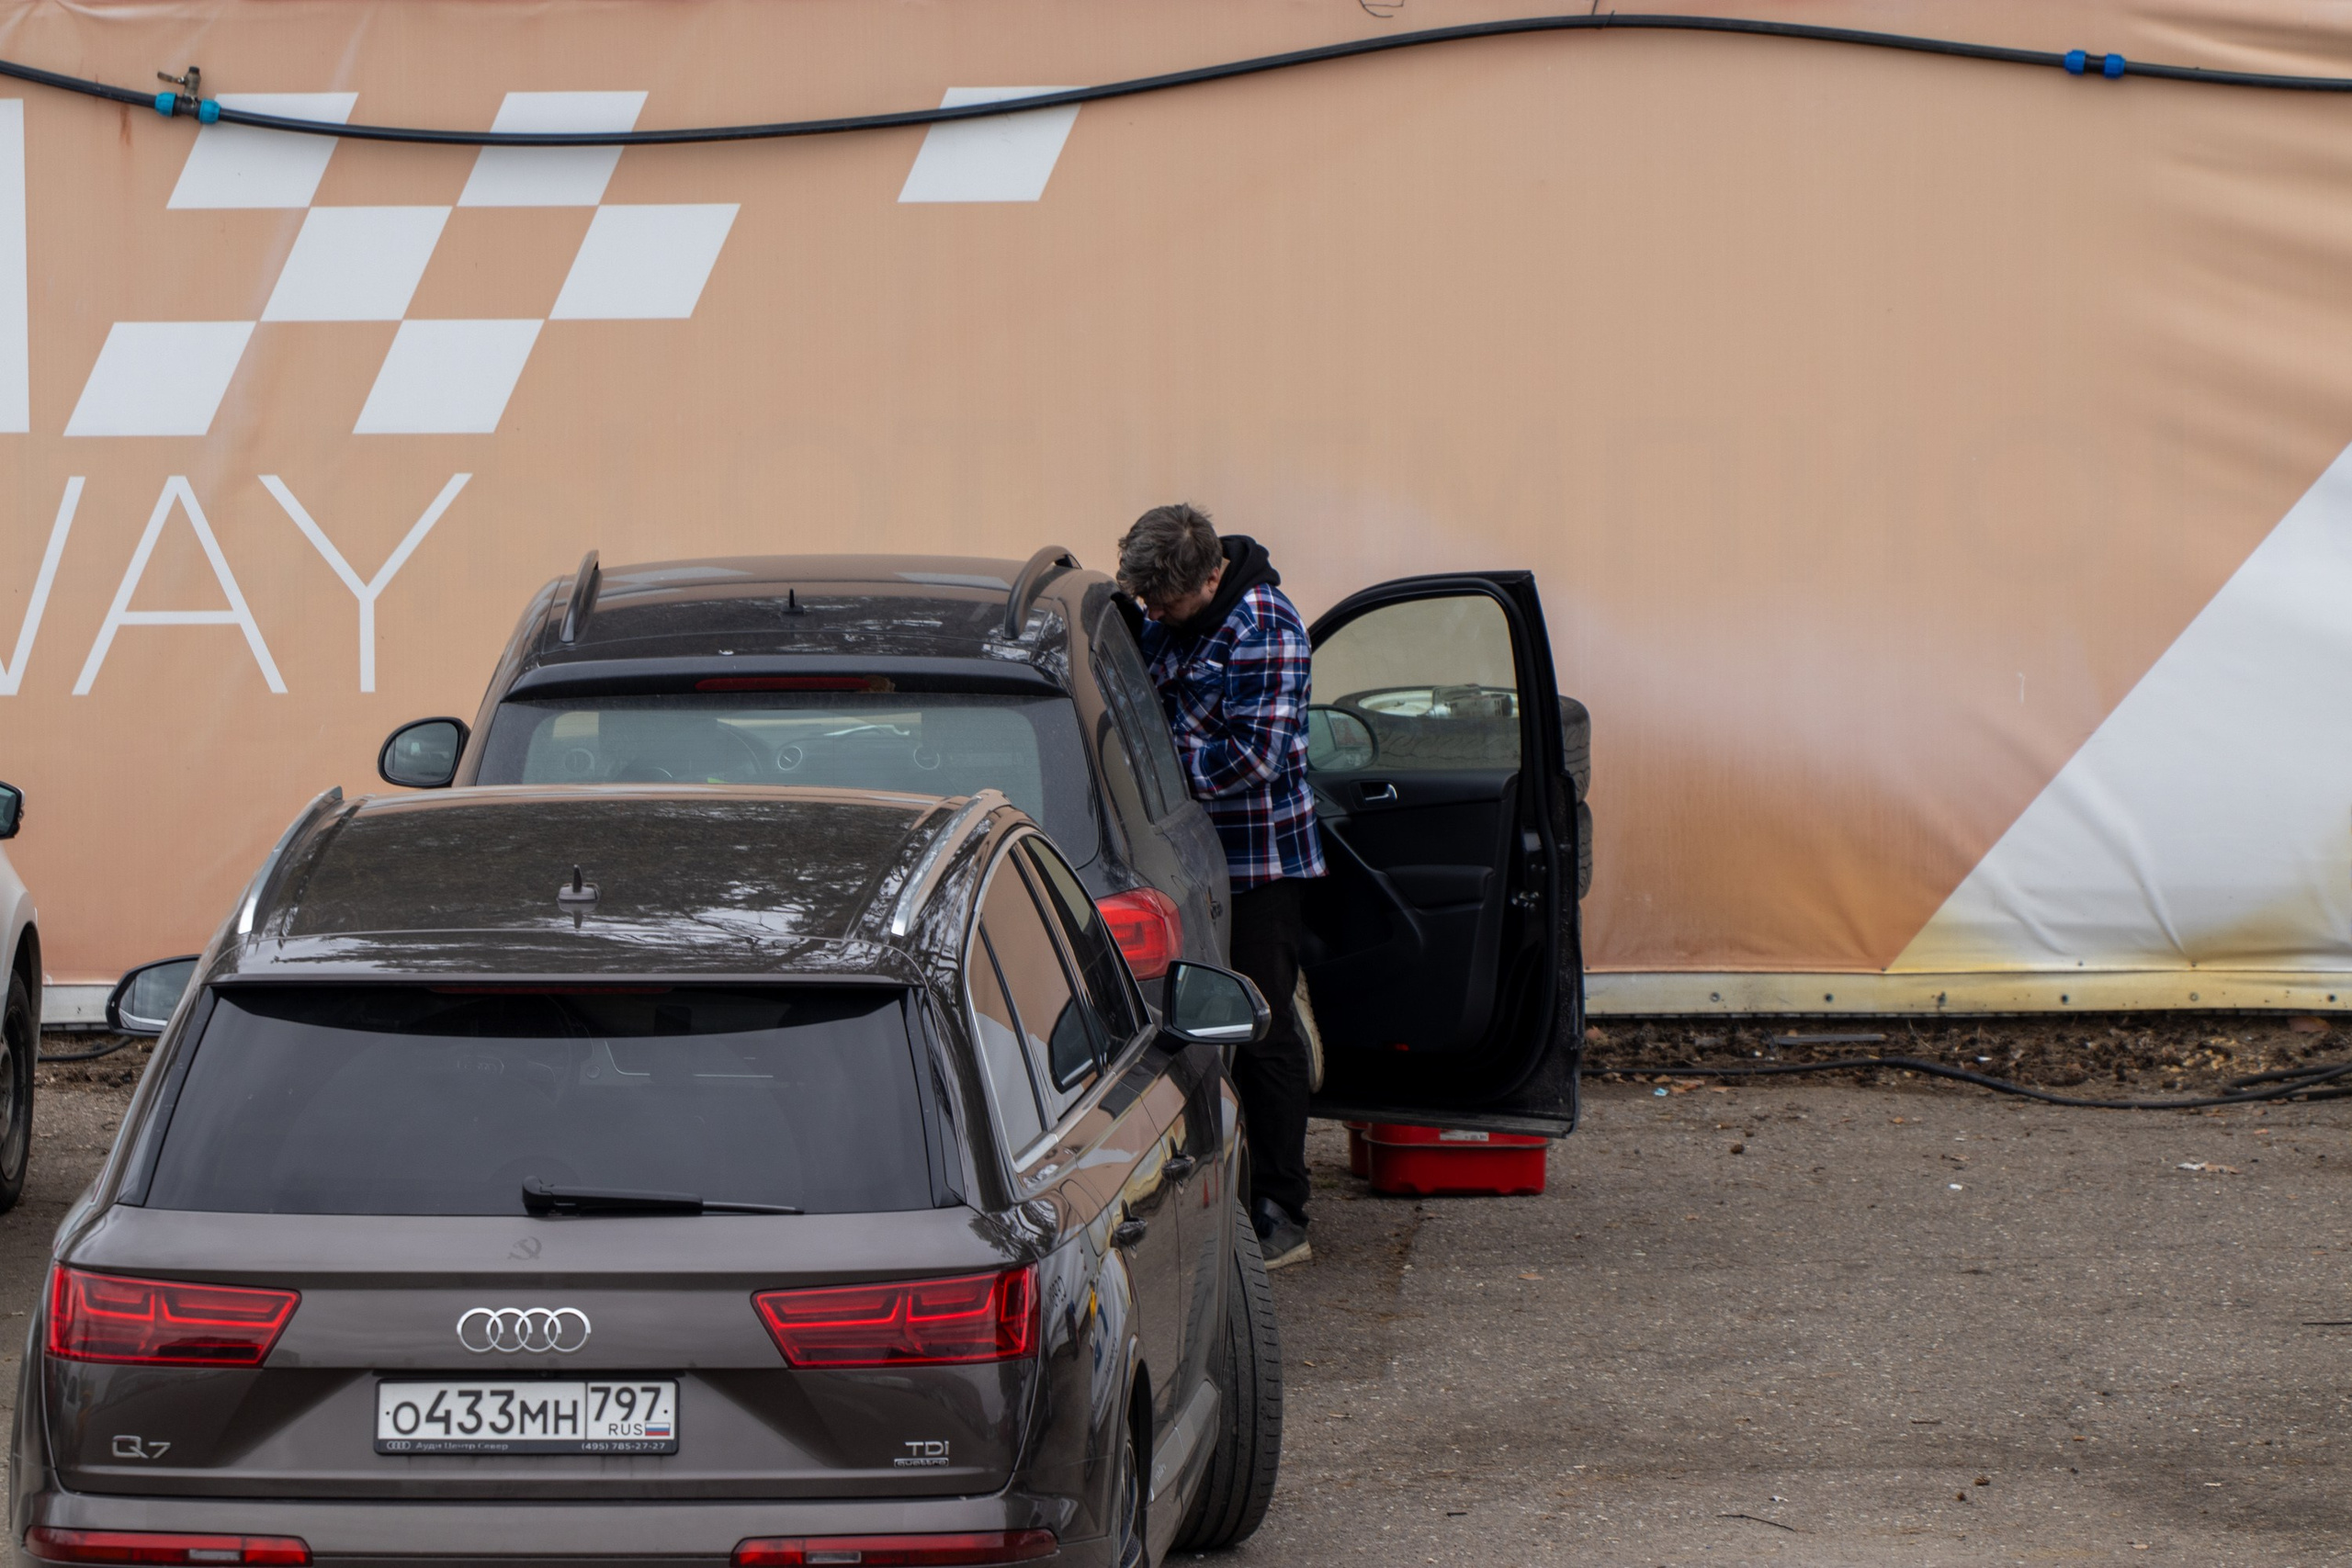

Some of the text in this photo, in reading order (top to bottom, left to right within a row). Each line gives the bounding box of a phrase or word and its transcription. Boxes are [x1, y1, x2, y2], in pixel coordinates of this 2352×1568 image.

[590, 1386, 662, 1422] 797
[608, 1423, 643, 1436] RUS
[112, 1435, 171, 1459] Q7
[415, 1441, 442, 1450] Ауди
[581, 1442, 666, 1450] (495) 785-27-27
